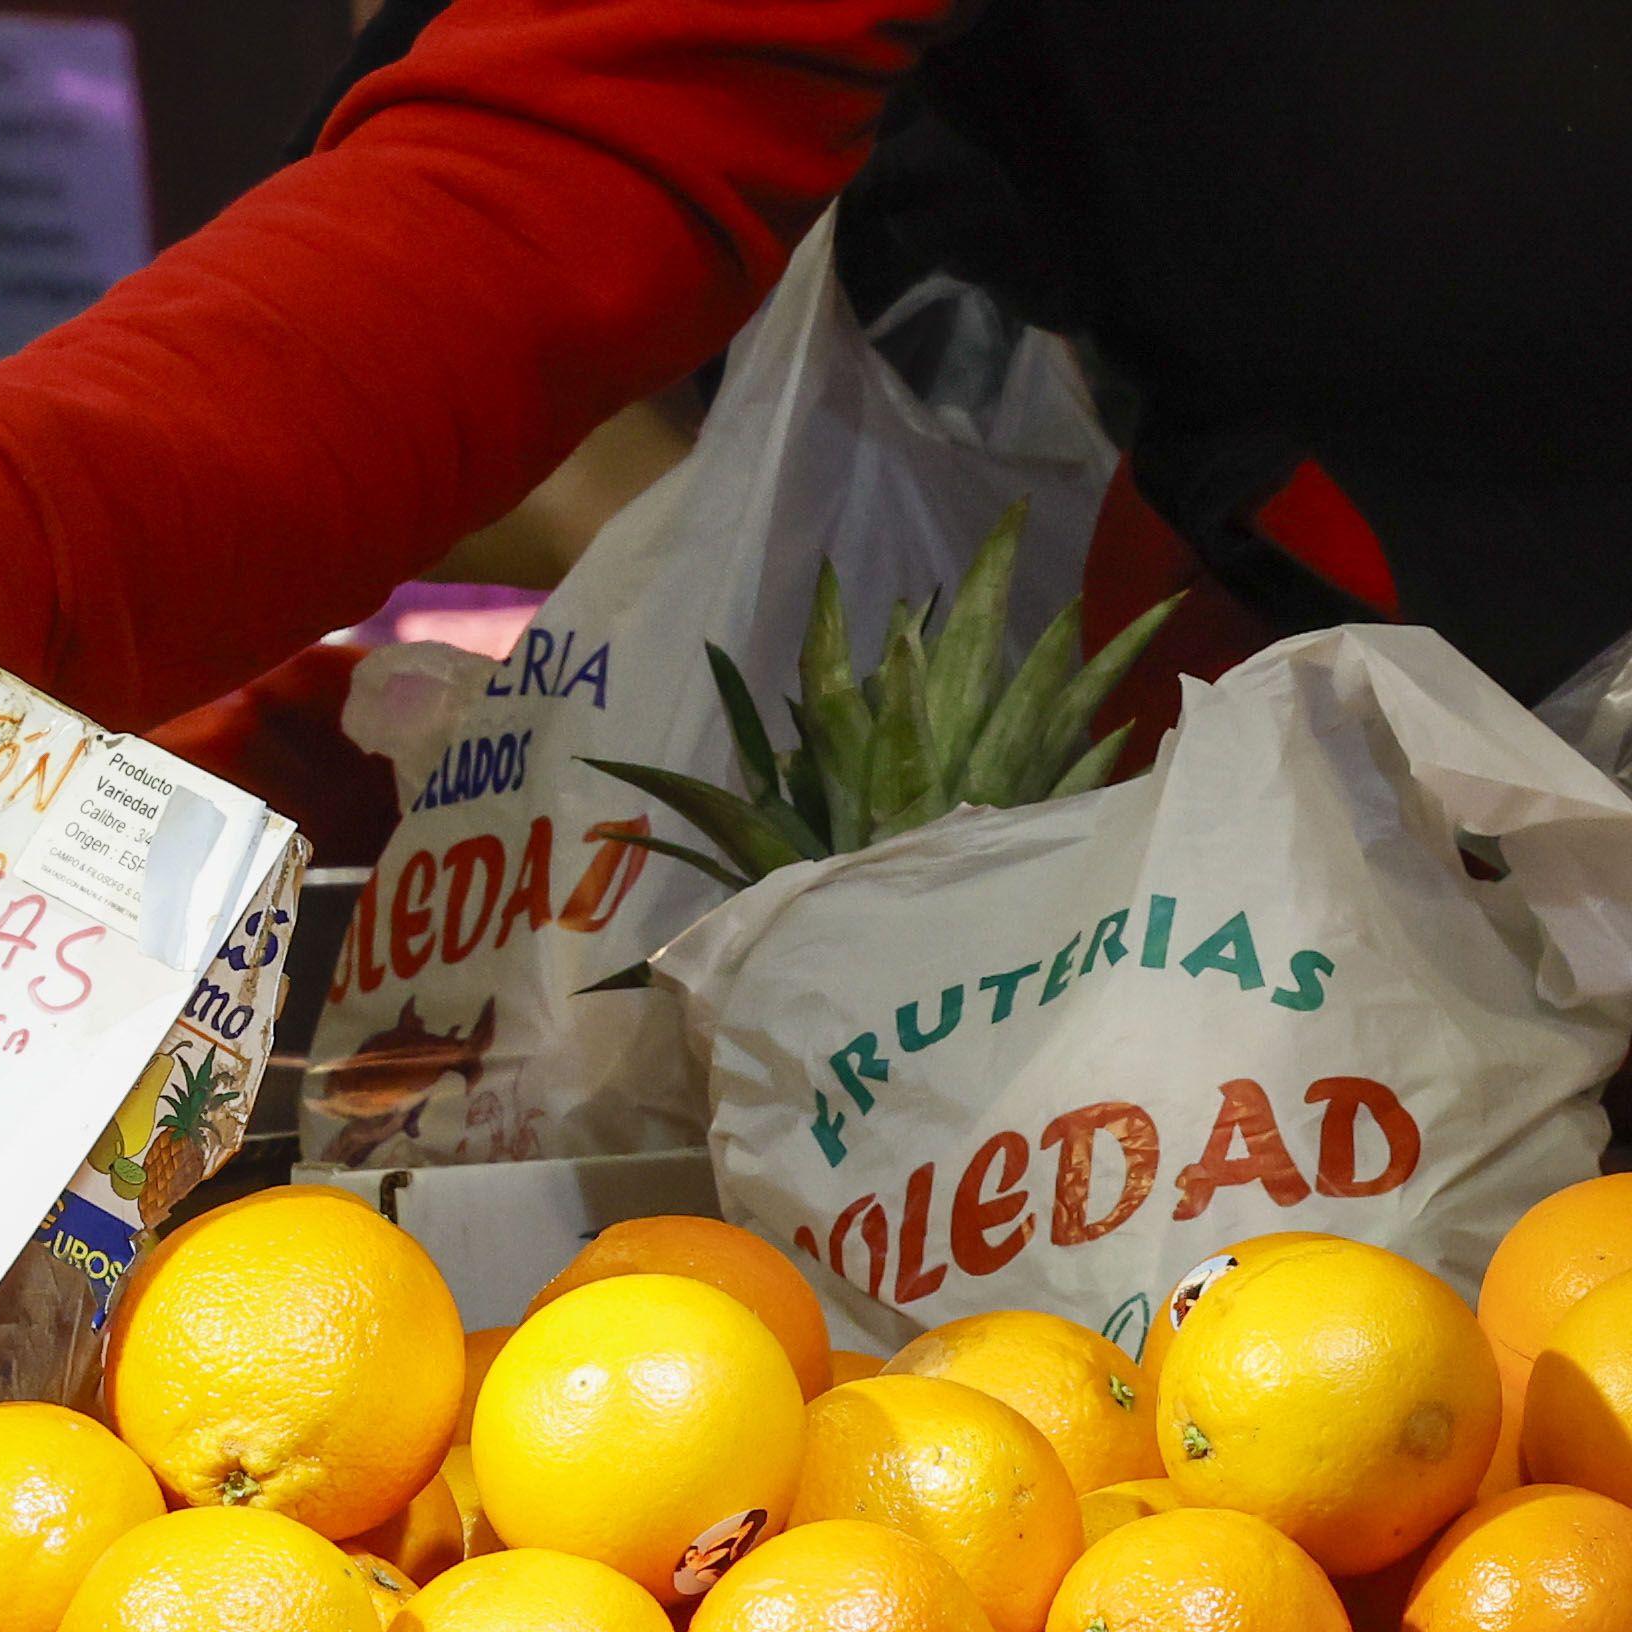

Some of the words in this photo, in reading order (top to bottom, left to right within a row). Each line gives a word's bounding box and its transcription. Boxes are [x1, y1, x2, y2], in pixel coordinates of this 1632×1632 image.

[108, 752, 173, 797] Producto
[79, 799, 127, 834] Calibre
[95, 775, 160, 821] Variedad
[64, 821, 111, 857] Origen
[810, 894, 1335, 1169] FRUTERIAS
